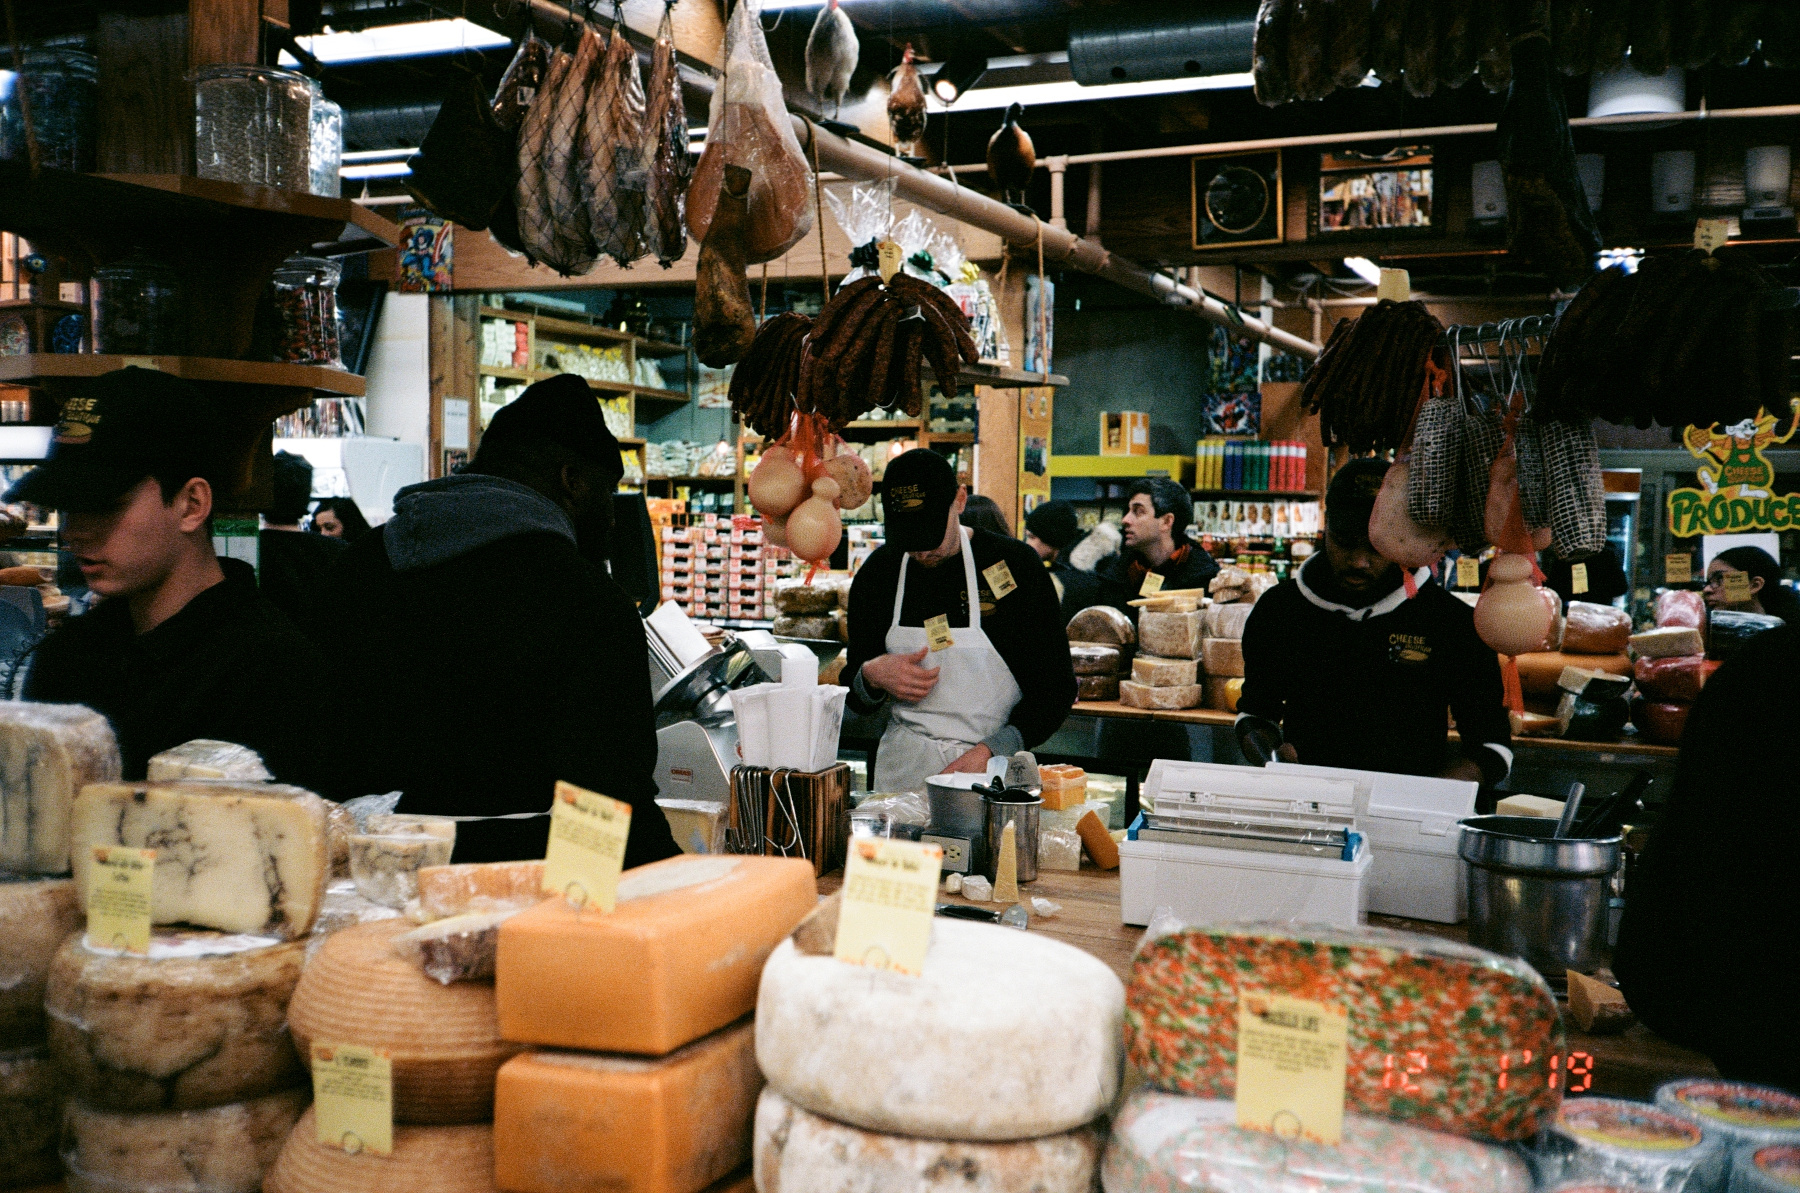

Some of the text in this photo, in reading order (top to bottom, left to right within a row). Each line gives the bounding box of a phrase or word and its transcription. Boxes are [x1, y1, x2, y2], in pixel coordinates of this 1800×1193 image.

[890, 484, 919, 498] CHEESE
[1671, 491, 1800, 533] PRODUCE
[1389, 633, 1426, 645] CHEESE
